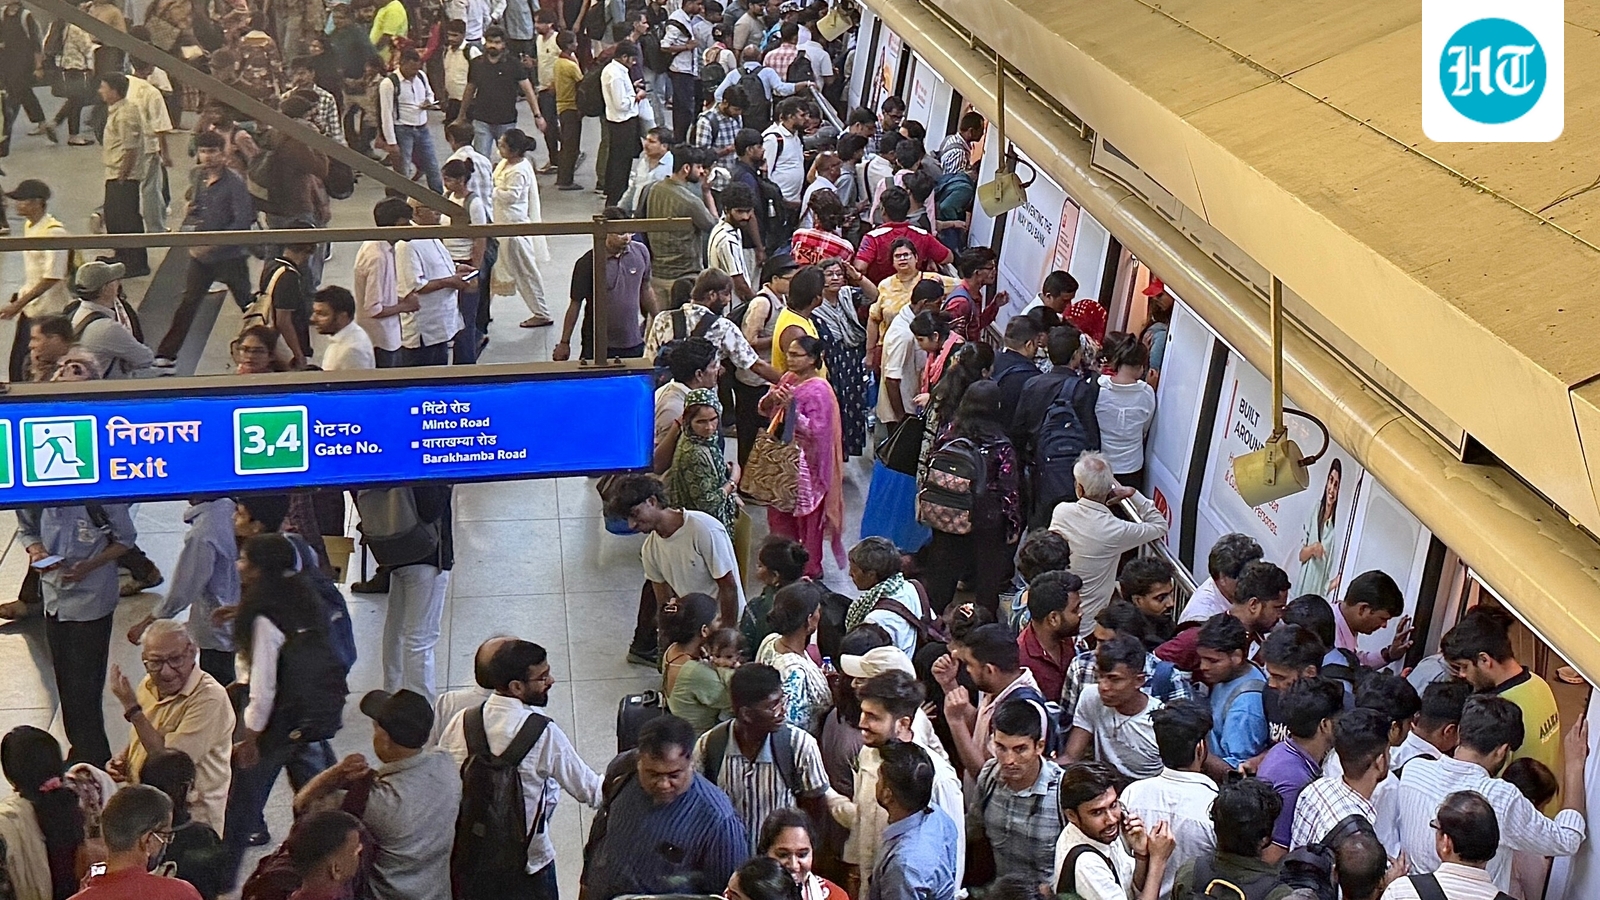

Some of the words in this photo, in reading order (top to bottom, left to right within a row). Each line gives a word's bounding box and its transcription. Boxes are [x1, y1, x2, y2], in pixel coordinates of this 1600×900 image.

[422, 399, 447, 415] मिंटो
[450, 399, 471, 414] रोड
[1238, 398, 1260, 428] BUILT
[106, 416, 202, 446] निकास
[314, 420, 336, 437] गेट
[422, 420, 458, 430] Minto
[460, 417, 490, 429] Road
[243, 424, 301, 457] 3,4
[476, 432, 497, 446] रोड
[314, 442, 352, 456] Gate
[356, 441, 383, 454] No.
[422, 451, 495, 464] Barakhamba
[497, 448, 527, 461] Road
[109, 456, 168, 480] Exit
